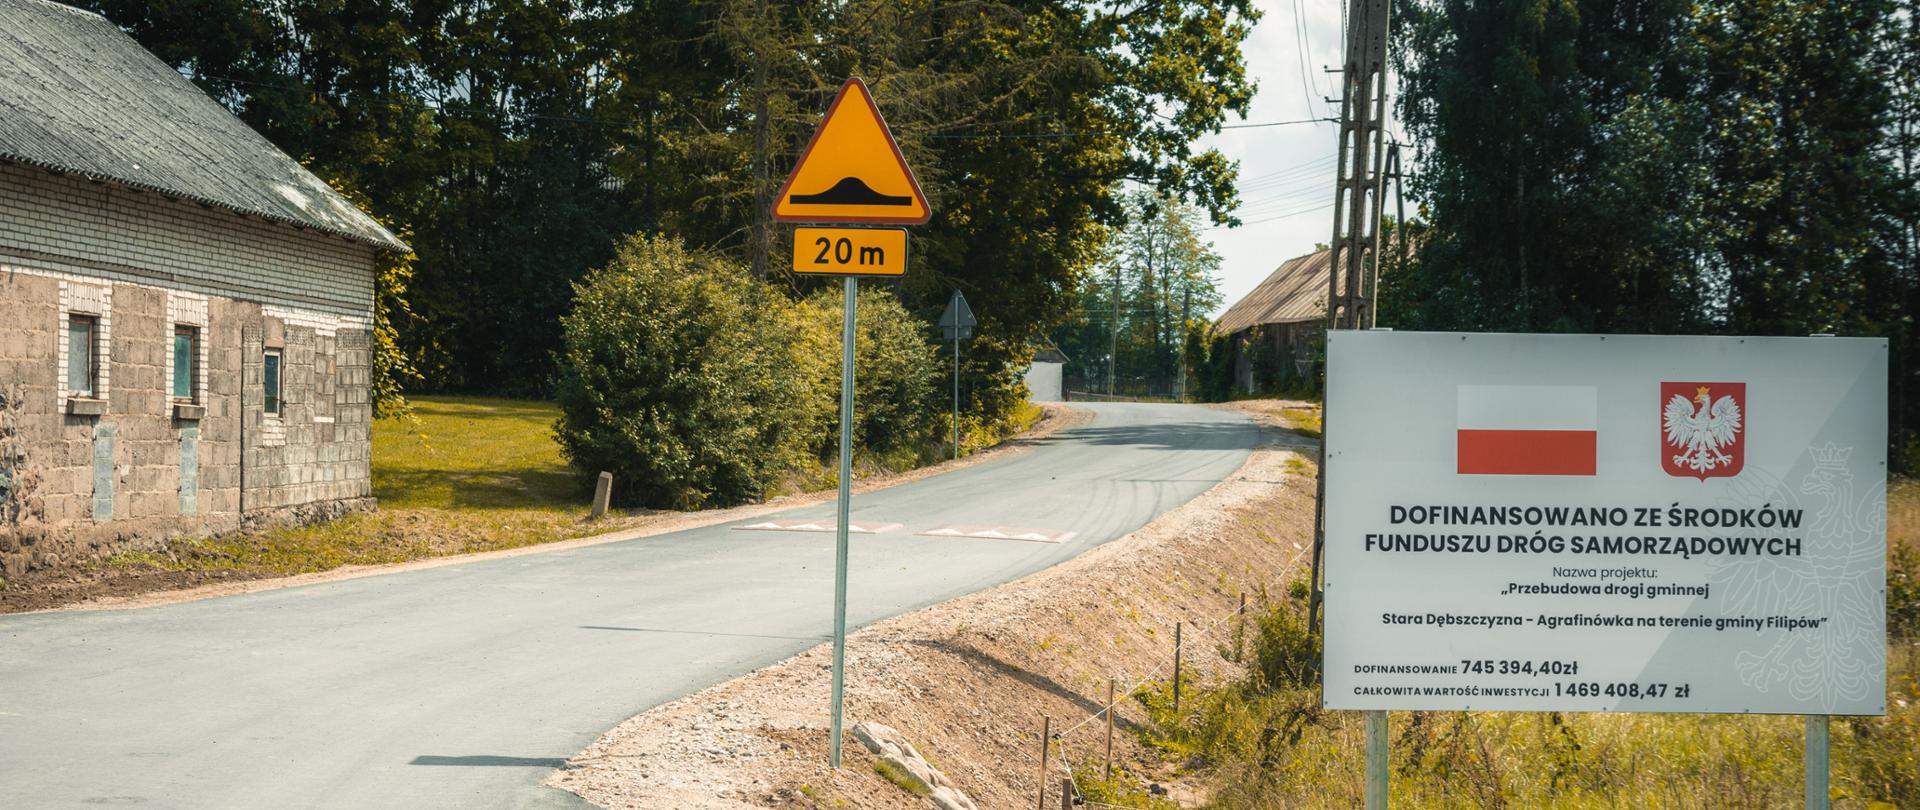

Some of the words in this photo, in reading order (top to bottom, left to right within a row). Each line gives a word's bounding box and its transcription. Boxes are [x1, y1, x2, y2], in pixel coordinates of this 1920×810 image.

[813, 236, 853, 265] 20
[859, 246, 885, 266] m
[1390, 505, 1628, 527] DOFINANSOWANO
[1633, 507, 1662, 527] ZE
[1667, 502, 1804, 529] ŚRODKÓW
[1365, 534, 1491, 553] FUNDUSZU
[1497, 530, 1566, 554] DRÓG
[1570, 536, 1802, 560] SAMORZĄDOWYCH
[1552, 566, 1597, 578] Nazwa
[1600, 566, 1659, 582] projektu:
[1604, 583, 1644, 599] drogi
[1646, 583, 1710, 600] gminnej
[1381, 613, 1423, 625] Stara
[1426, 613, 1523, 629] Dębszczyzna
[1537, 614, 1634, 630] Agrafinówka
[1636, 618, 1657, 628] na
[1658, 615, 1713, 628] terenie
[1715, 615, 1764, 632] gminy
[1354, 664, 1458, 675] DOFINANSOWANIE
[1461, 660, 1495, 675] 745
[1499, 660, 1579, 677] 394,40zł
[1353, 686, 1422, 696] CAŁKOWITA
[1423, 685, 1479, 697] WARTOŚĆ
[1481, 687, 1550, 697] INWESTYCJI
[1604, 683, 1669, 700] 408,47
[1674, 683, 1691, 699] zł
